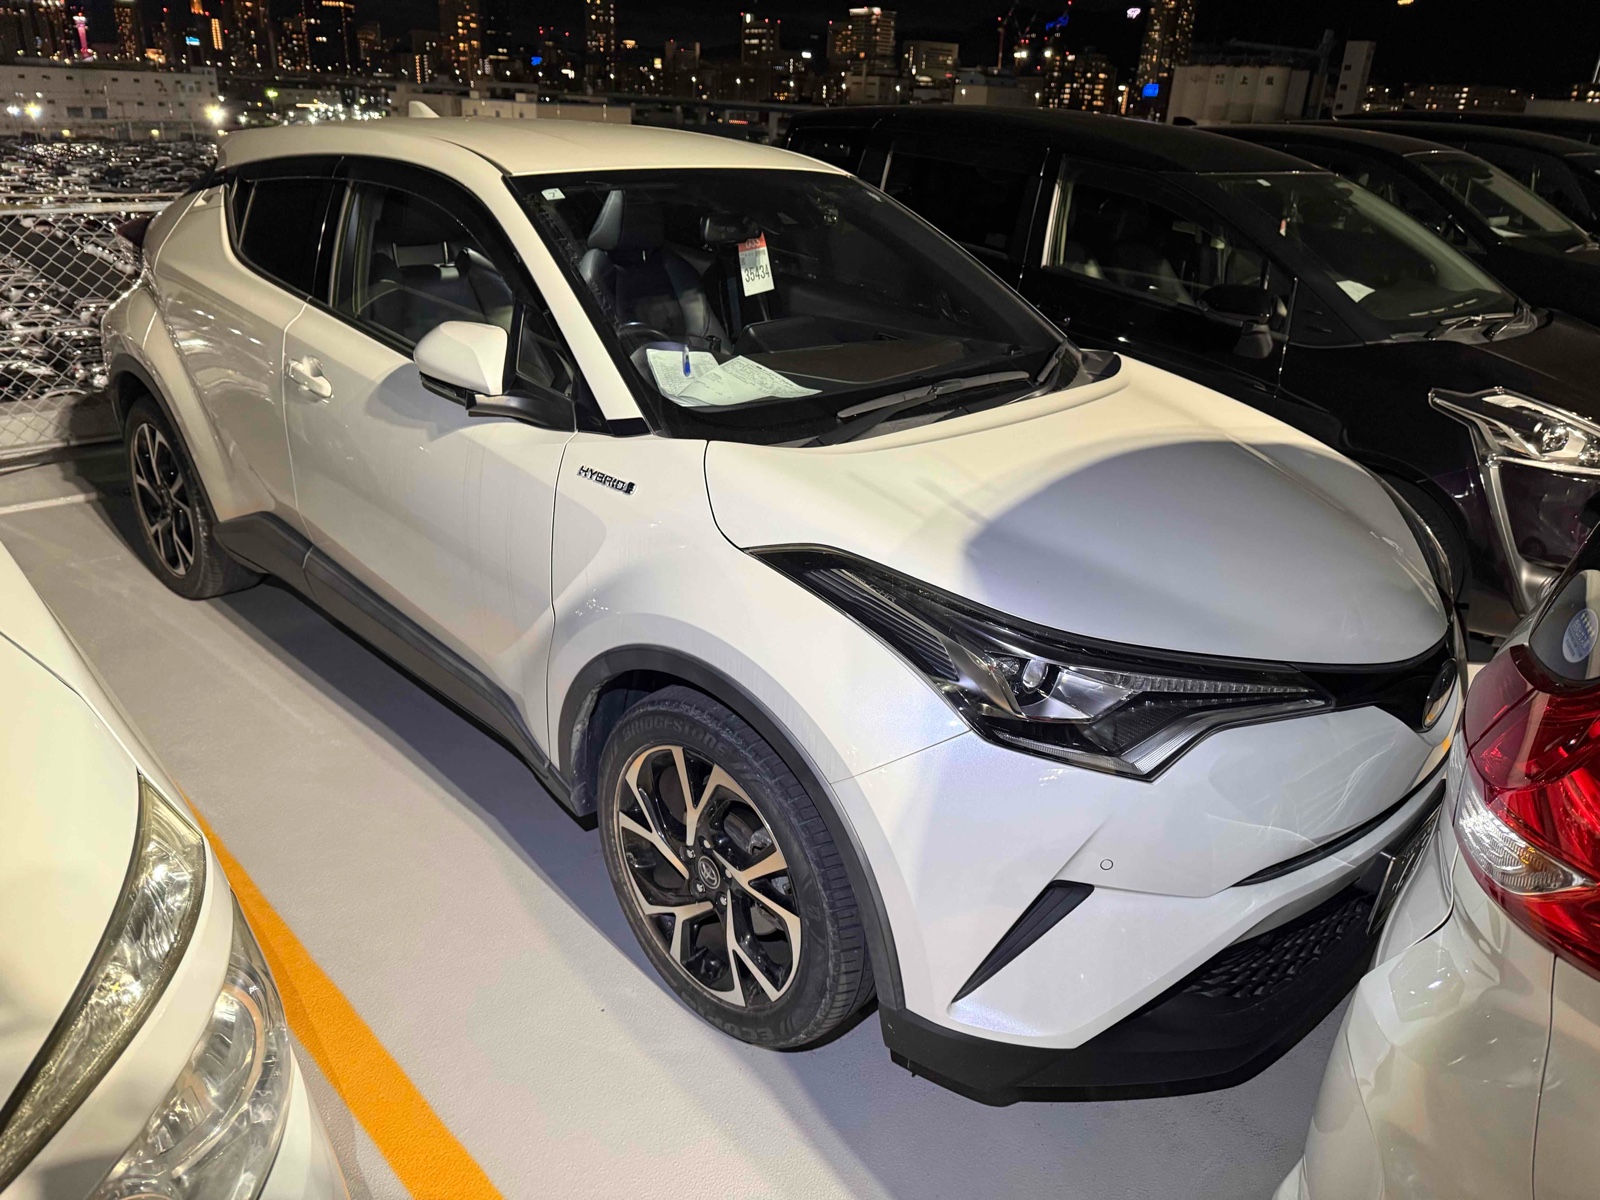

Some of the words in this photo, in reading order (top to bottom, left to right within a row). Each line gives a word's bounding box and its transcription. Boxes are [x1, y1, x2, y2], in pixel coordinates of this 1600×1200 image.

[744, 264, 770, 283] 35434
[577, 465, 626, 491] HYBRID
[622, 715, 729, 757] BRIDGESTONE
